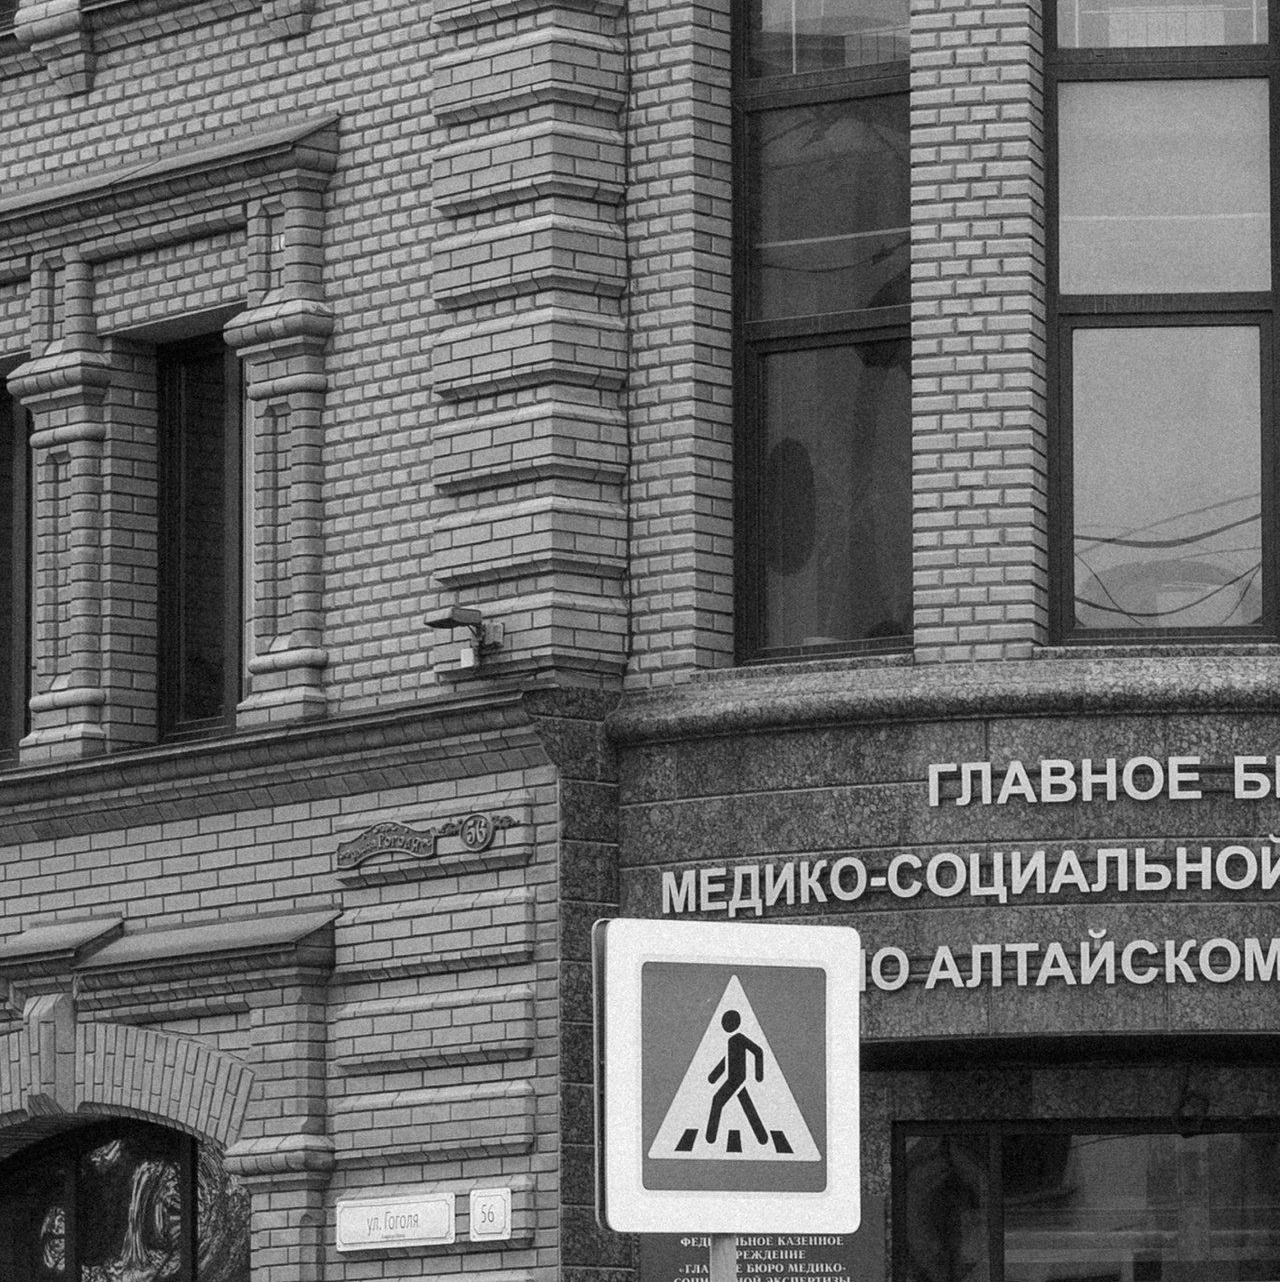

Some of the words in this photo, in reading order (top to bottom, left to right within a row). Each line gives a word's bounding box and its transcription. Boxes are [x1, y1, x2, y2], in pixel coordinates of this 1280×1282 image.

[928, 756, 1203, 807] ГЛАВНОЕ
[466, 819, 487, 845] 56
[860, 947, 910, 991] О
[366, 1217, 382, 1236] ул.
[384, 1211, 419, 1230] Гоголя
[481, 1204, 495, 1224] 56
[777, 1236, 844, 1246] КАЗЕННОЕ
[735, 1249, 806, 1261] РЕЖДЕНИЕ
[679, 1264, 742, 1274] «ГЛАЕ
[746, 1262, 784, 1273] БЮРО
[788, 1262, 847, 1274] МЕДИКО-
